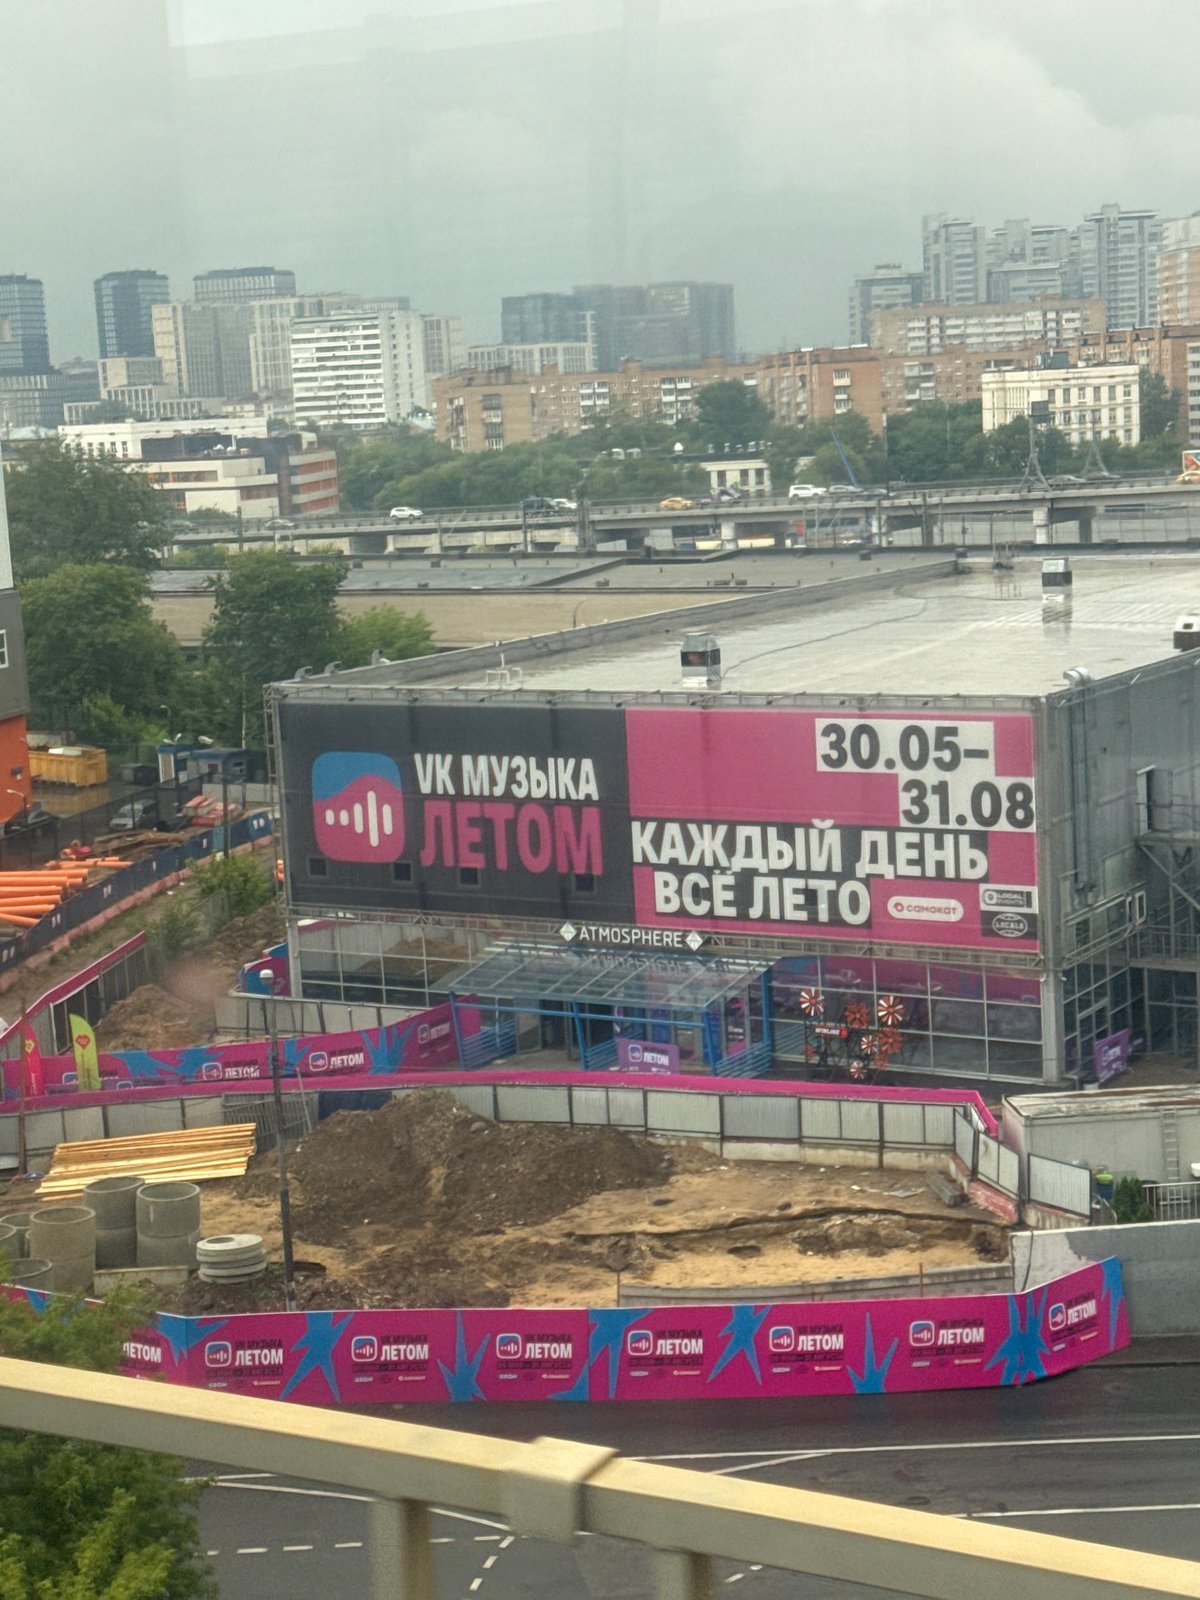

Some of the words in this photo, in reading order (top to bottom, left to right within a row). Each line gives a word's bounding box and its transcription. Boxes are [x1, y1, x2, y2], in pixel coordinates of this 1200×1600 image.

[414, 753, 455, 795] VK
[461, 754, 599, 801] МУЗЫКА
[901, 779, 1034, 829] 31.08
[420, 800, 603, 876] ЛЕТОМ
[631, 818, 842, 873] КАЖДЫЙ
[856, 830, 988, 880] ДЕНЬ
[654, 870, 738, 917] ВСЁ
[749, 875, 871, 925] ЛЕТО
[579, 925, 684, 948] ATMOSPHERE
[330, 1052, 364, 1069] ЛЕТОМ
[1067, 1300, 1097, 1325] ЛЕТОМ
[655, 1338, 703, 1355] ЛЕТОМ
[797, 1334, 844, 1352] ЛЕТОМ
[937, 1327, 984, 1345] ЛЕТОМ
[234, 1348, 283, 1367] ЛЕТОМ
[380, 1343, 428, 1361] ЛЕТОМ
[524, 1343, 573, 1359] ЛЕТОМ
